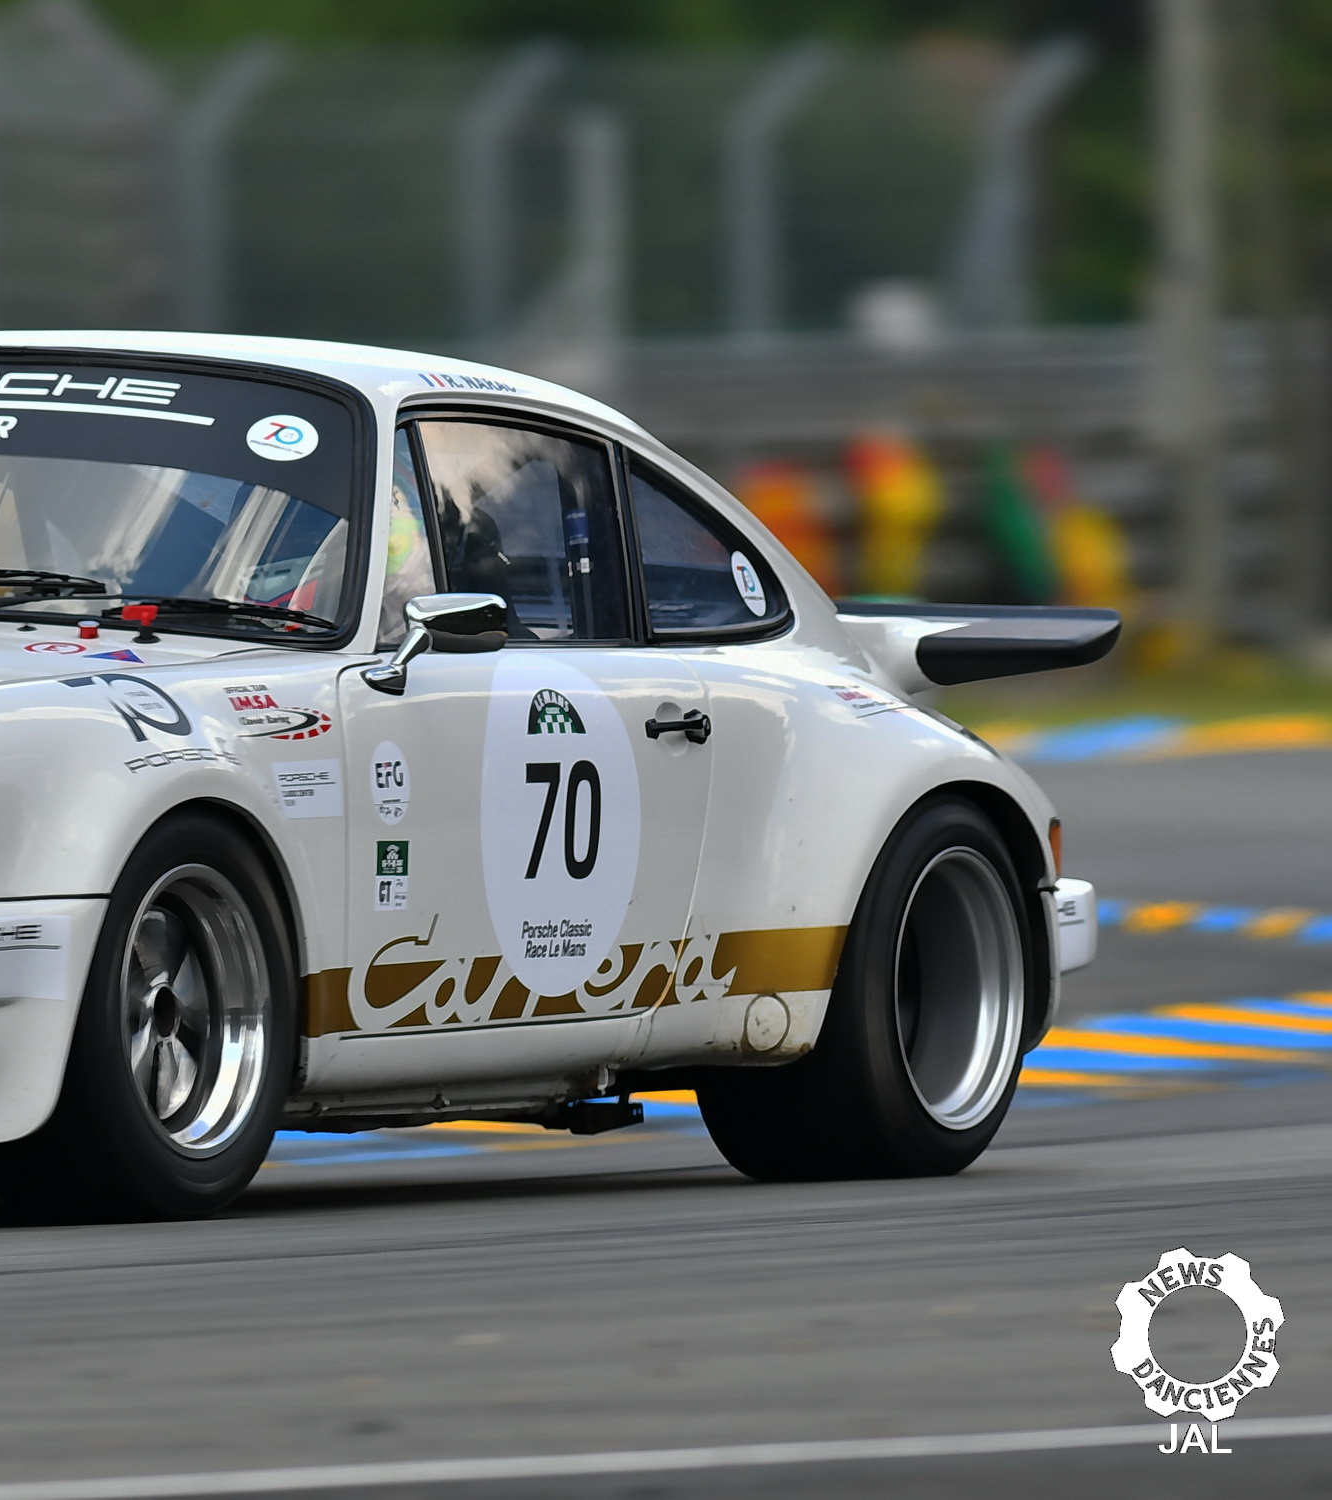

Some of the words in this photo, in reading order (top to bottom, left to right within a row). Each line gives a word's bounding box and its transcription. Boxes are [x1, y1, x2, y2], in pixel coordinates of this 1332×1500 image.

[374, 760, 404, 789] EFG
[525, 759, 602, 880] 70
[521, 919, 558, 939] Porsche
[559, 918, 593, 938] Classic
[524, 940, 548, 959] Race
[548, 939, 560, 958] Le
[560, 938, 586, 957] Mans
